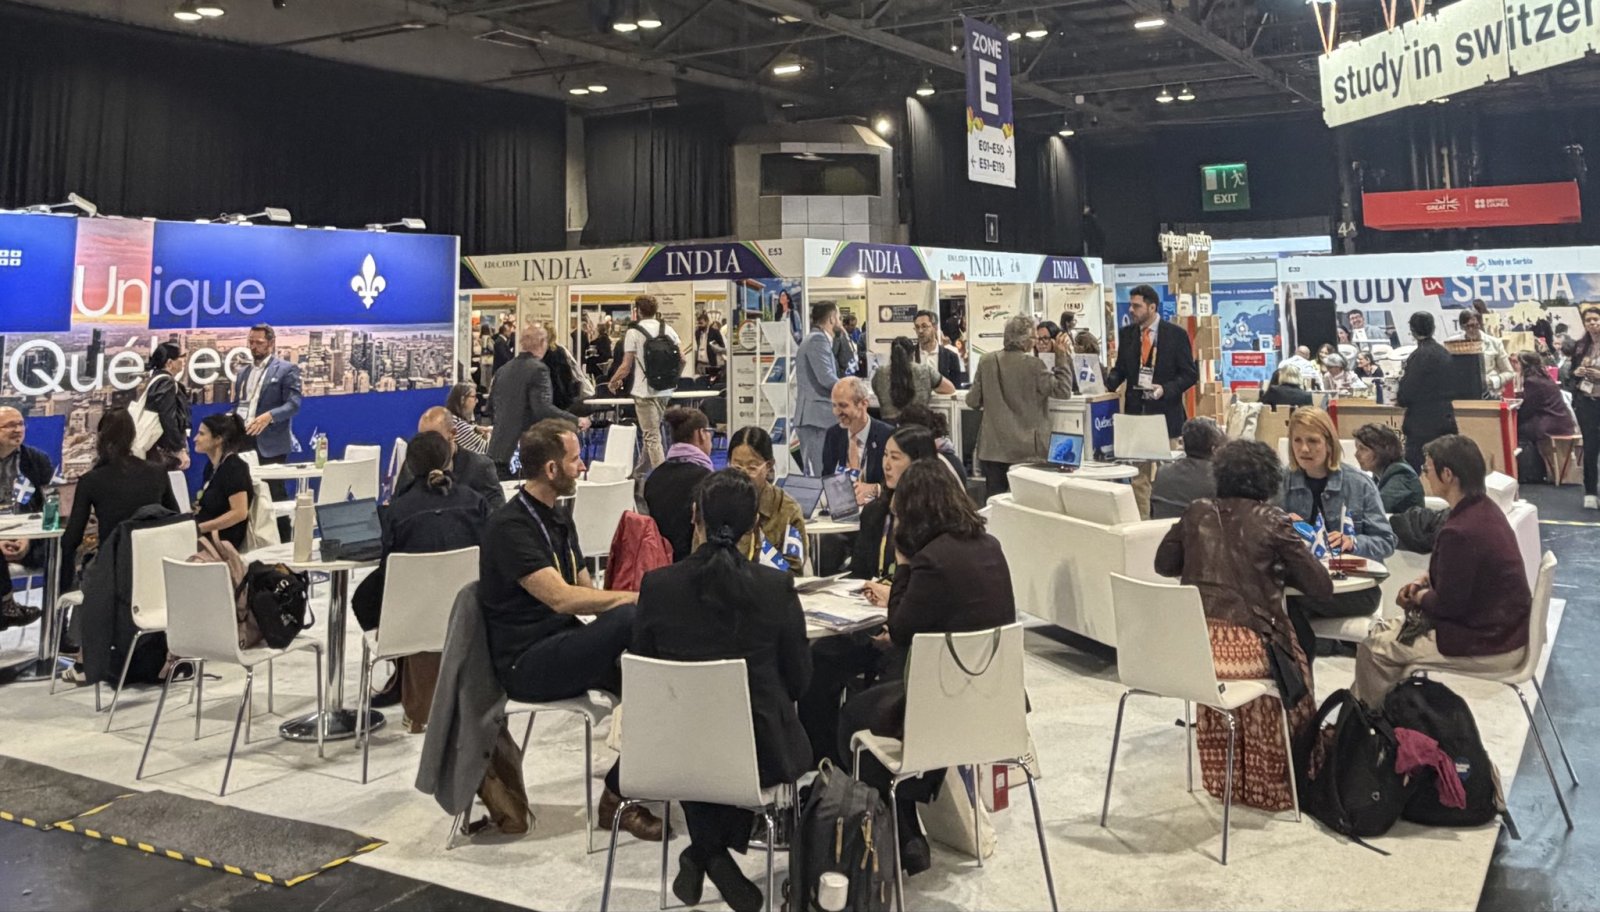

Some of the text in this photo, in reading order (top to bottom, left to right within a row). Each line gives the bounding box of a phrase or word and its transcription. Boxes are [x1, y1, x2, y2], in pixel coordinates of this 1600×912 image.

[972, 31, 1002, 60] ZONE
[1334, 51, 1404, 104] study
[1413, 39, 1442, 80] in
[979, 58, 999, 116] E
[1213, 192, 1239, 204] EXIT
[665, 248, 743, 276] INDIA
[768, 247, 783, 256] E53
[858, 248, 903, 275] INDIA
[1052, 259, 1080, 280] INDIA
[73, 265, 267, 328] Unique
[1317, 278, 1413, 304] STUDY
[1424, 279, 1444, 291] in
[1451, 272, 1575, 303] SERBIA
